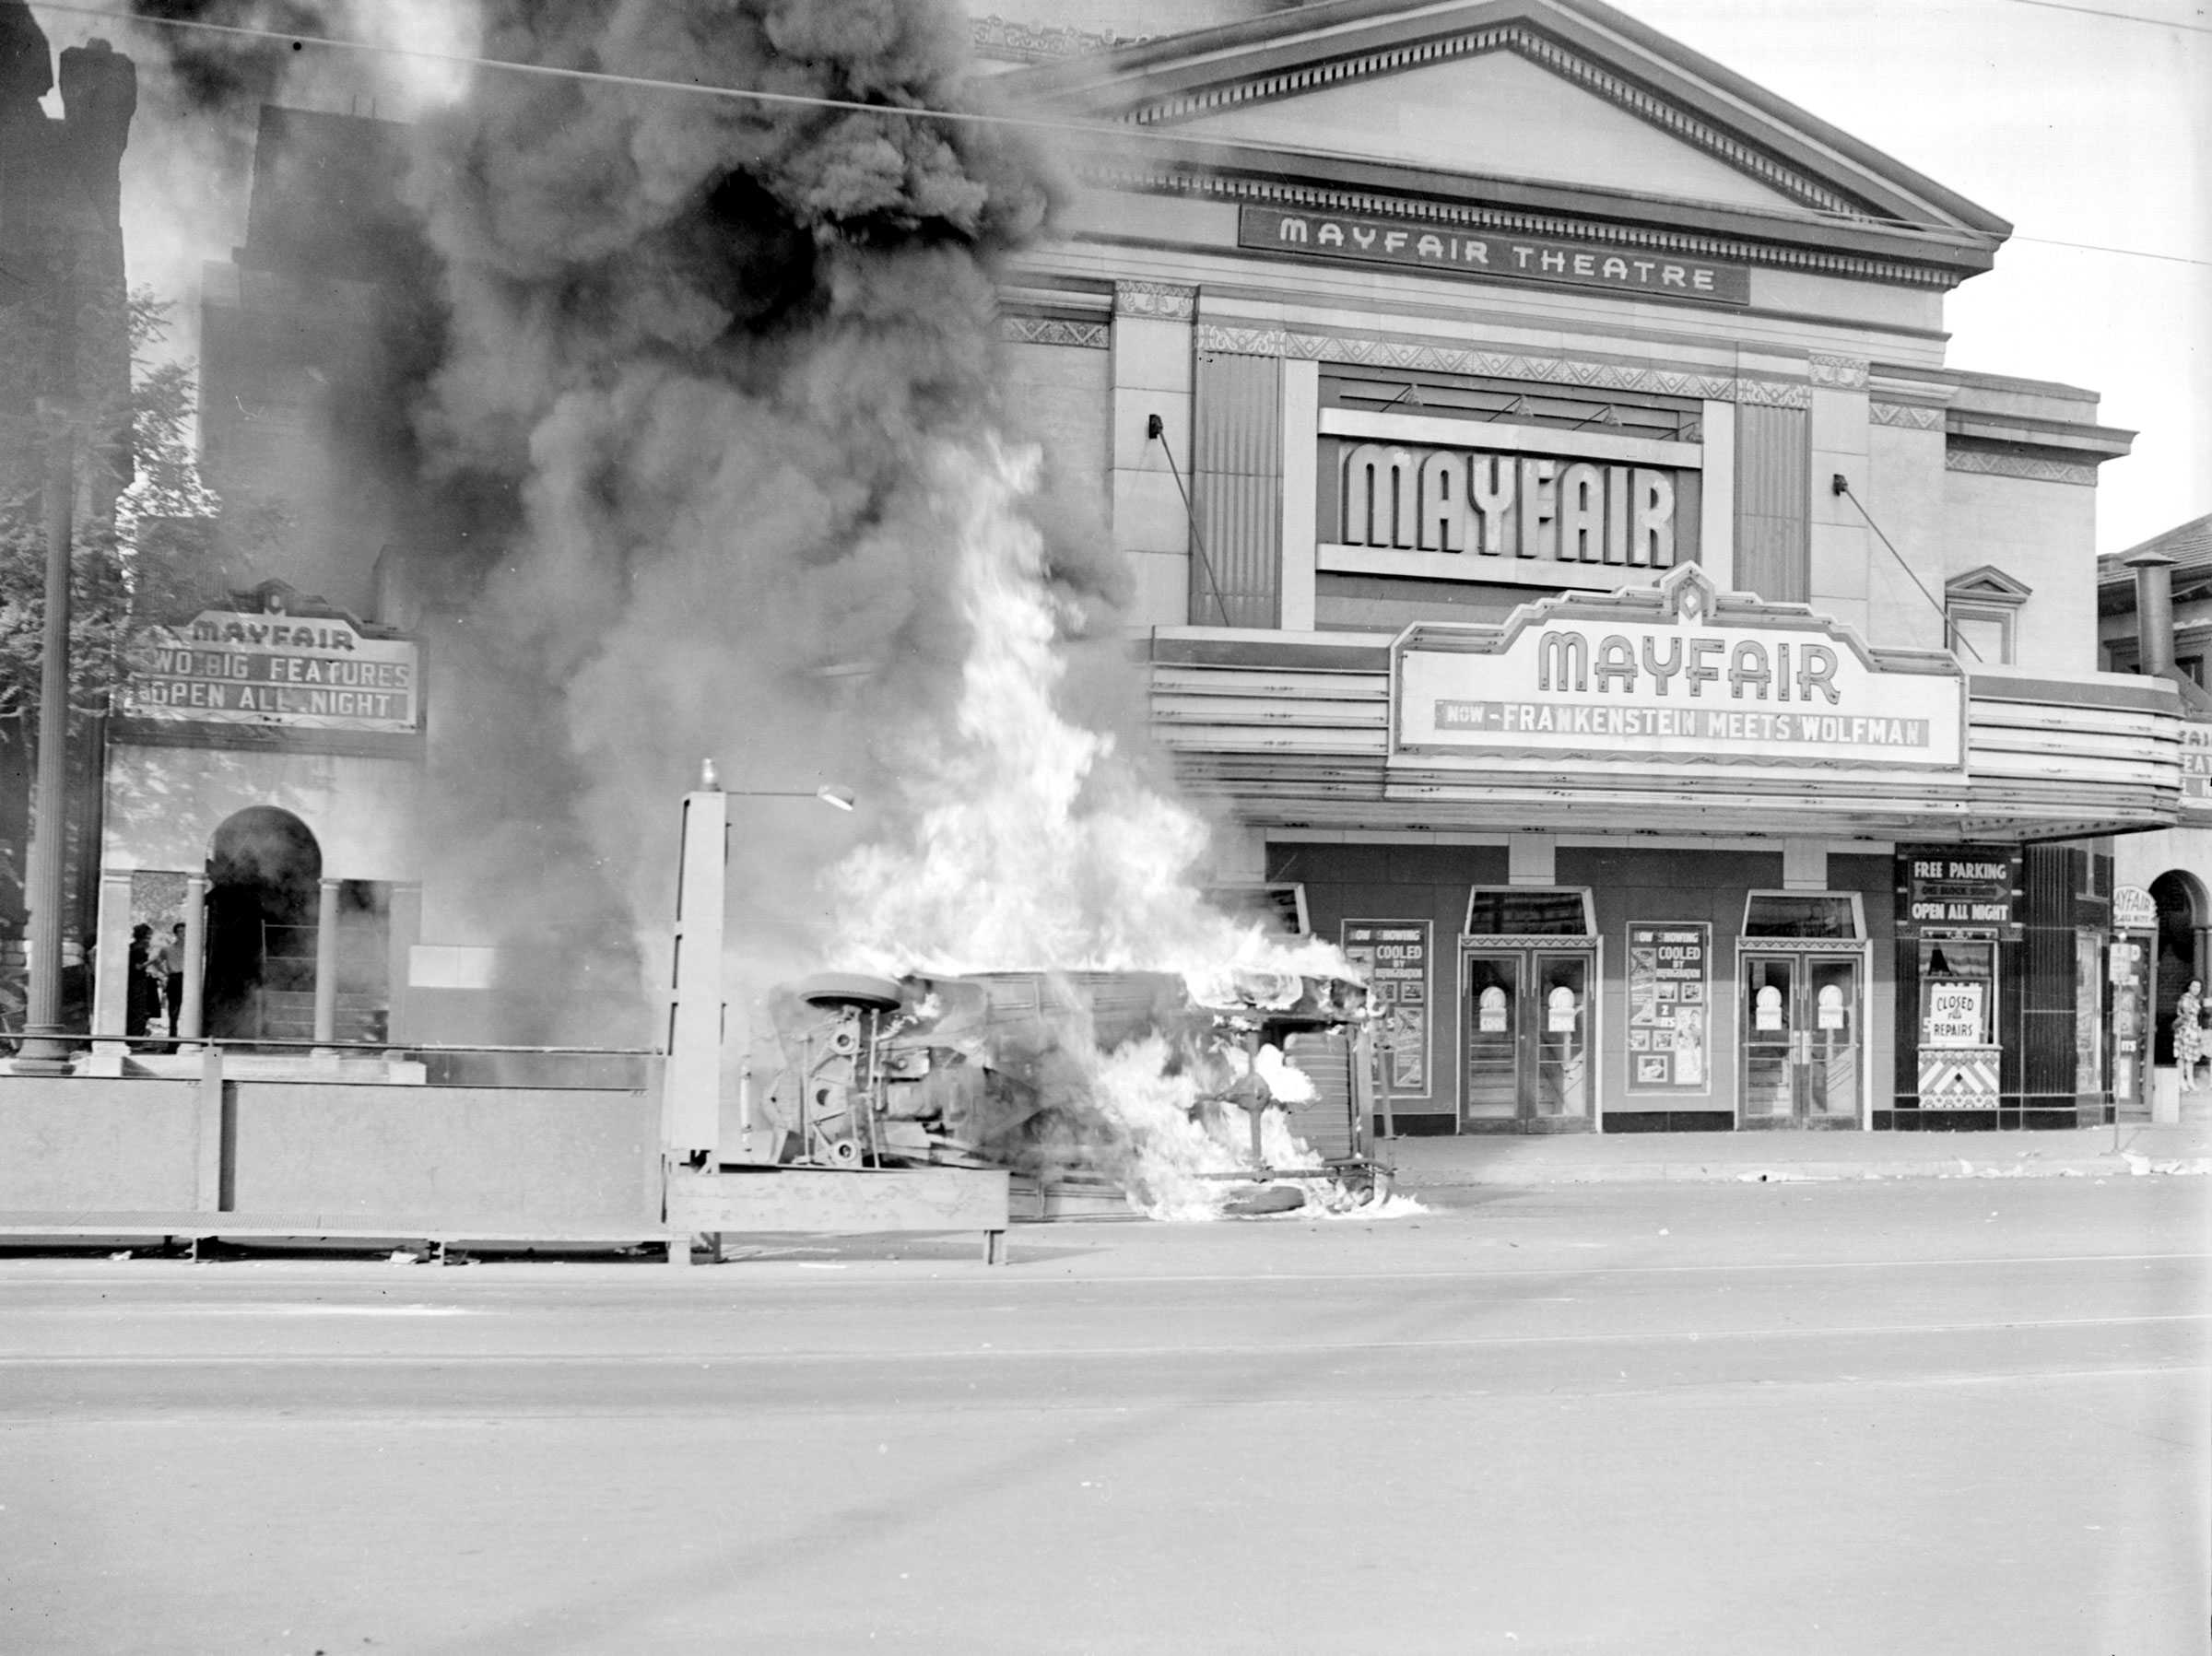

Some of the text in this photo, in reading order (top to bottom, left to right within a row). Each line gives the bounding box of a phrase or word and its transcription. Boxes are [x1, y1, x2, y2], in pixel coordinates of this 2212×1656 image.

[1279, 217, 1715, 291] MAYFAIR THEATRE
[1342, 443, 1675, 569] MAYFAIR
[194, 620, 355, 652] MAYFAIR
[155, 649, 409, 687] WO BIG FEATURES
[1538, 630, 1841, 705] MAYFAIR
[151, 681, 391, 717] OPEN ALL NIGHT
[1446, 705, 1485, 723] NOW
[1503, 704, 1697, 736] FRANKENSTEIN
[1707, 711, 1792, 741] MEETS
[1801, 714, 1920, 746] WOLFMAN
[1913, 861, 2007, 880] FREE PARKING
[1912, 903, 2009, 922] OPEN ALL NIGHT
[2113, 889, 2151, 911] AYFAIR
[1376, 945, 1423, 959] COOLED
[1659, 945, 1701, 960] COOLED
[1936, 995, 1975, 1012] CLOSED
[1933, 1023, 1973, 1037] REPAIRS
